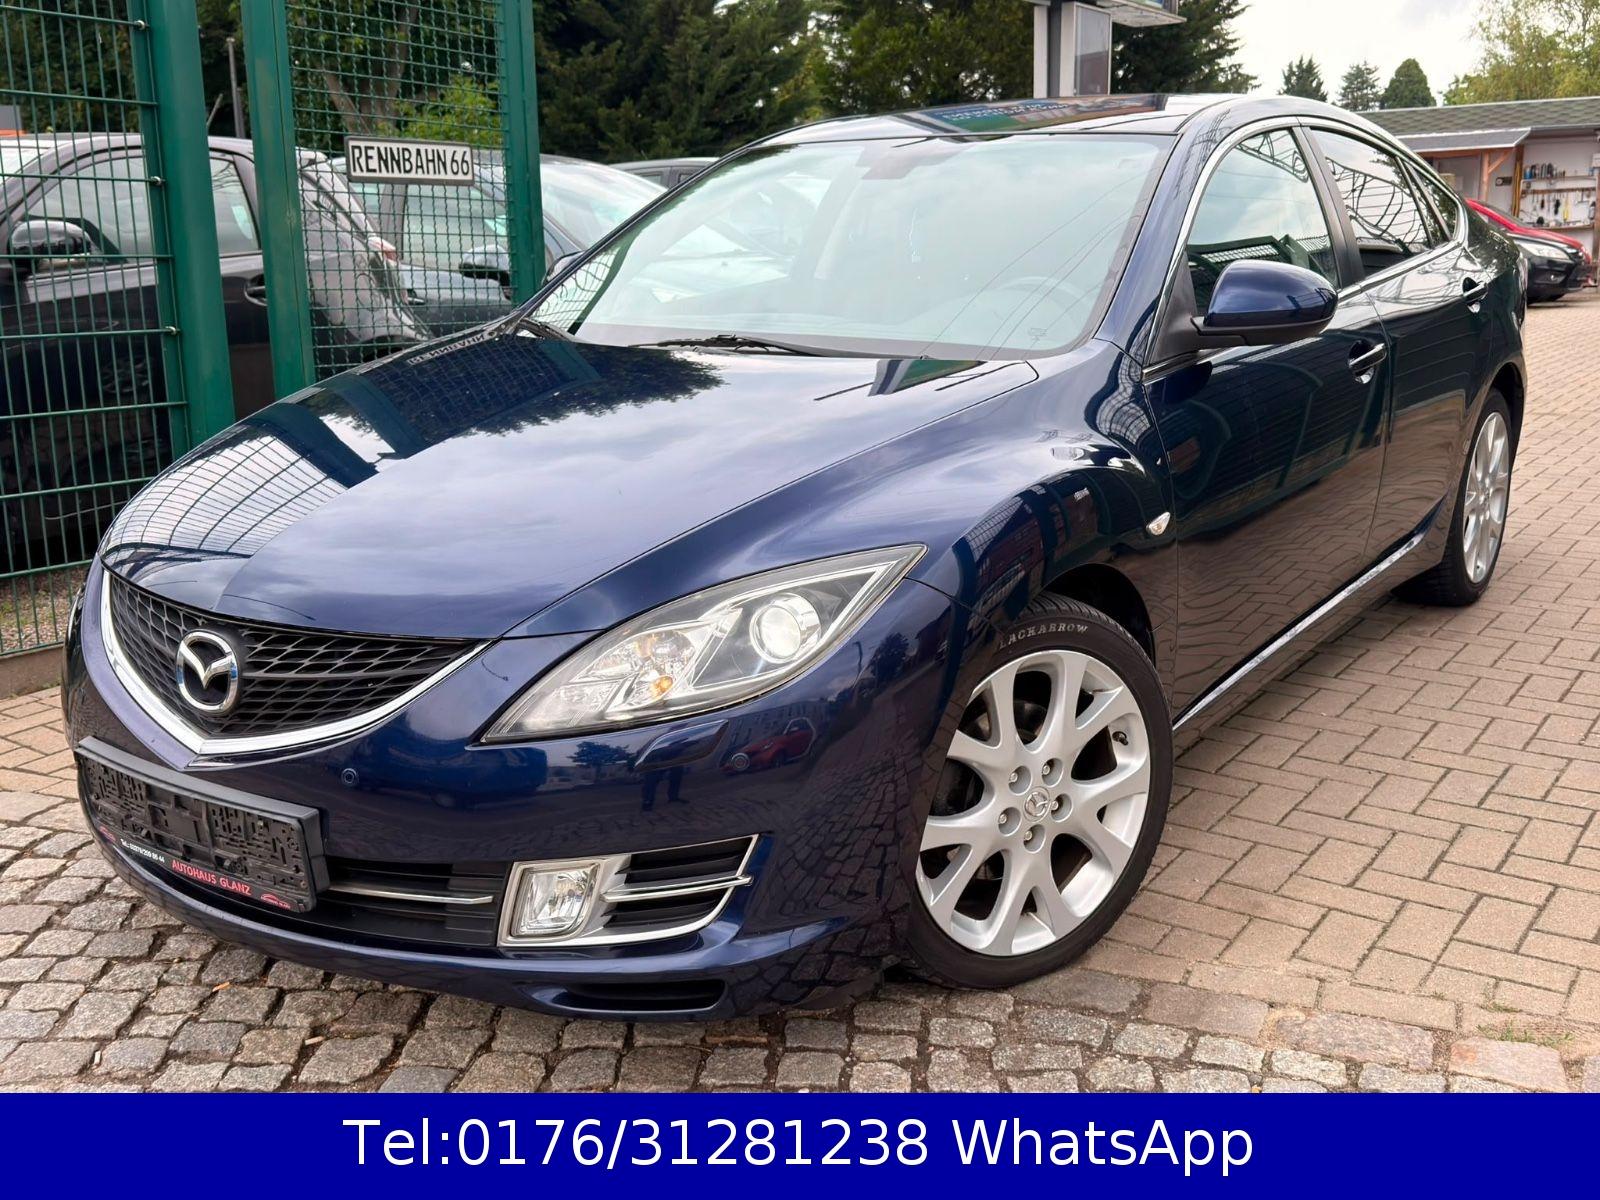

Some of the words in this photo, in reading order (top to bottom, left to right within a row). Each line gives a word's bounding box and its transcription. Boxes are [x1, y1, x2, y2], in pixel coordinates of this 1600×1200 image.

[351, 145, 448, 176] RENNBAHN
[450, 150, 470, 176] 66
[171, 859, 217, 885] AUTOHAUS
[219, 877, 252, 896] GLANZ
